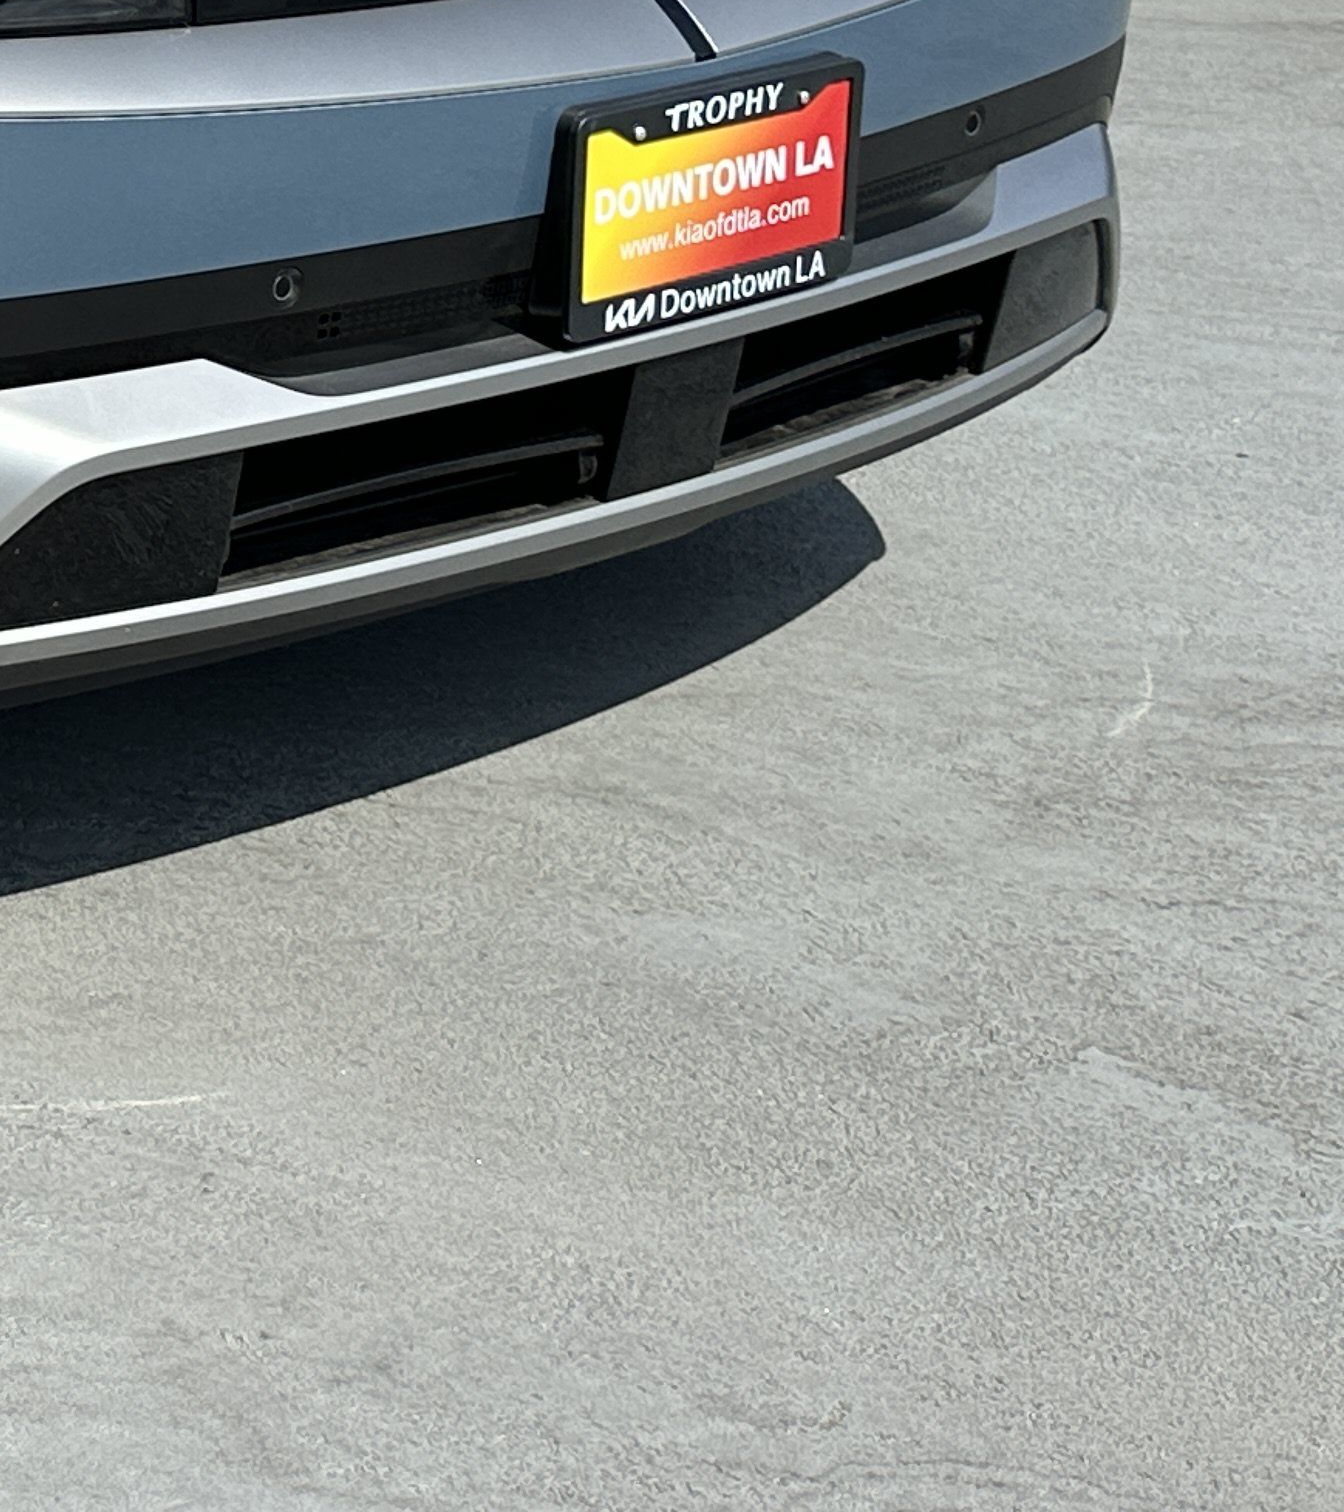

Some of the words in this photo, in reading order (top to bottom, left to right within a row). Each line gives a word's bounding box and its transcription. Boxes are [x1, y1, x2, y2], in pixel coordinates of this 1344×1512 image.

[665, 82, 784, 132] TROPHY
[593, 145, 787, 226] DOWNTOWN
[795, 135, 835, 175] LA
[619, 195, 810, 261] www.kiaofdtla.com
[604, 295, 656, 333] KIA
[660, 264, 791, 319] Downtown
[796, 250, 826, 284] LA
